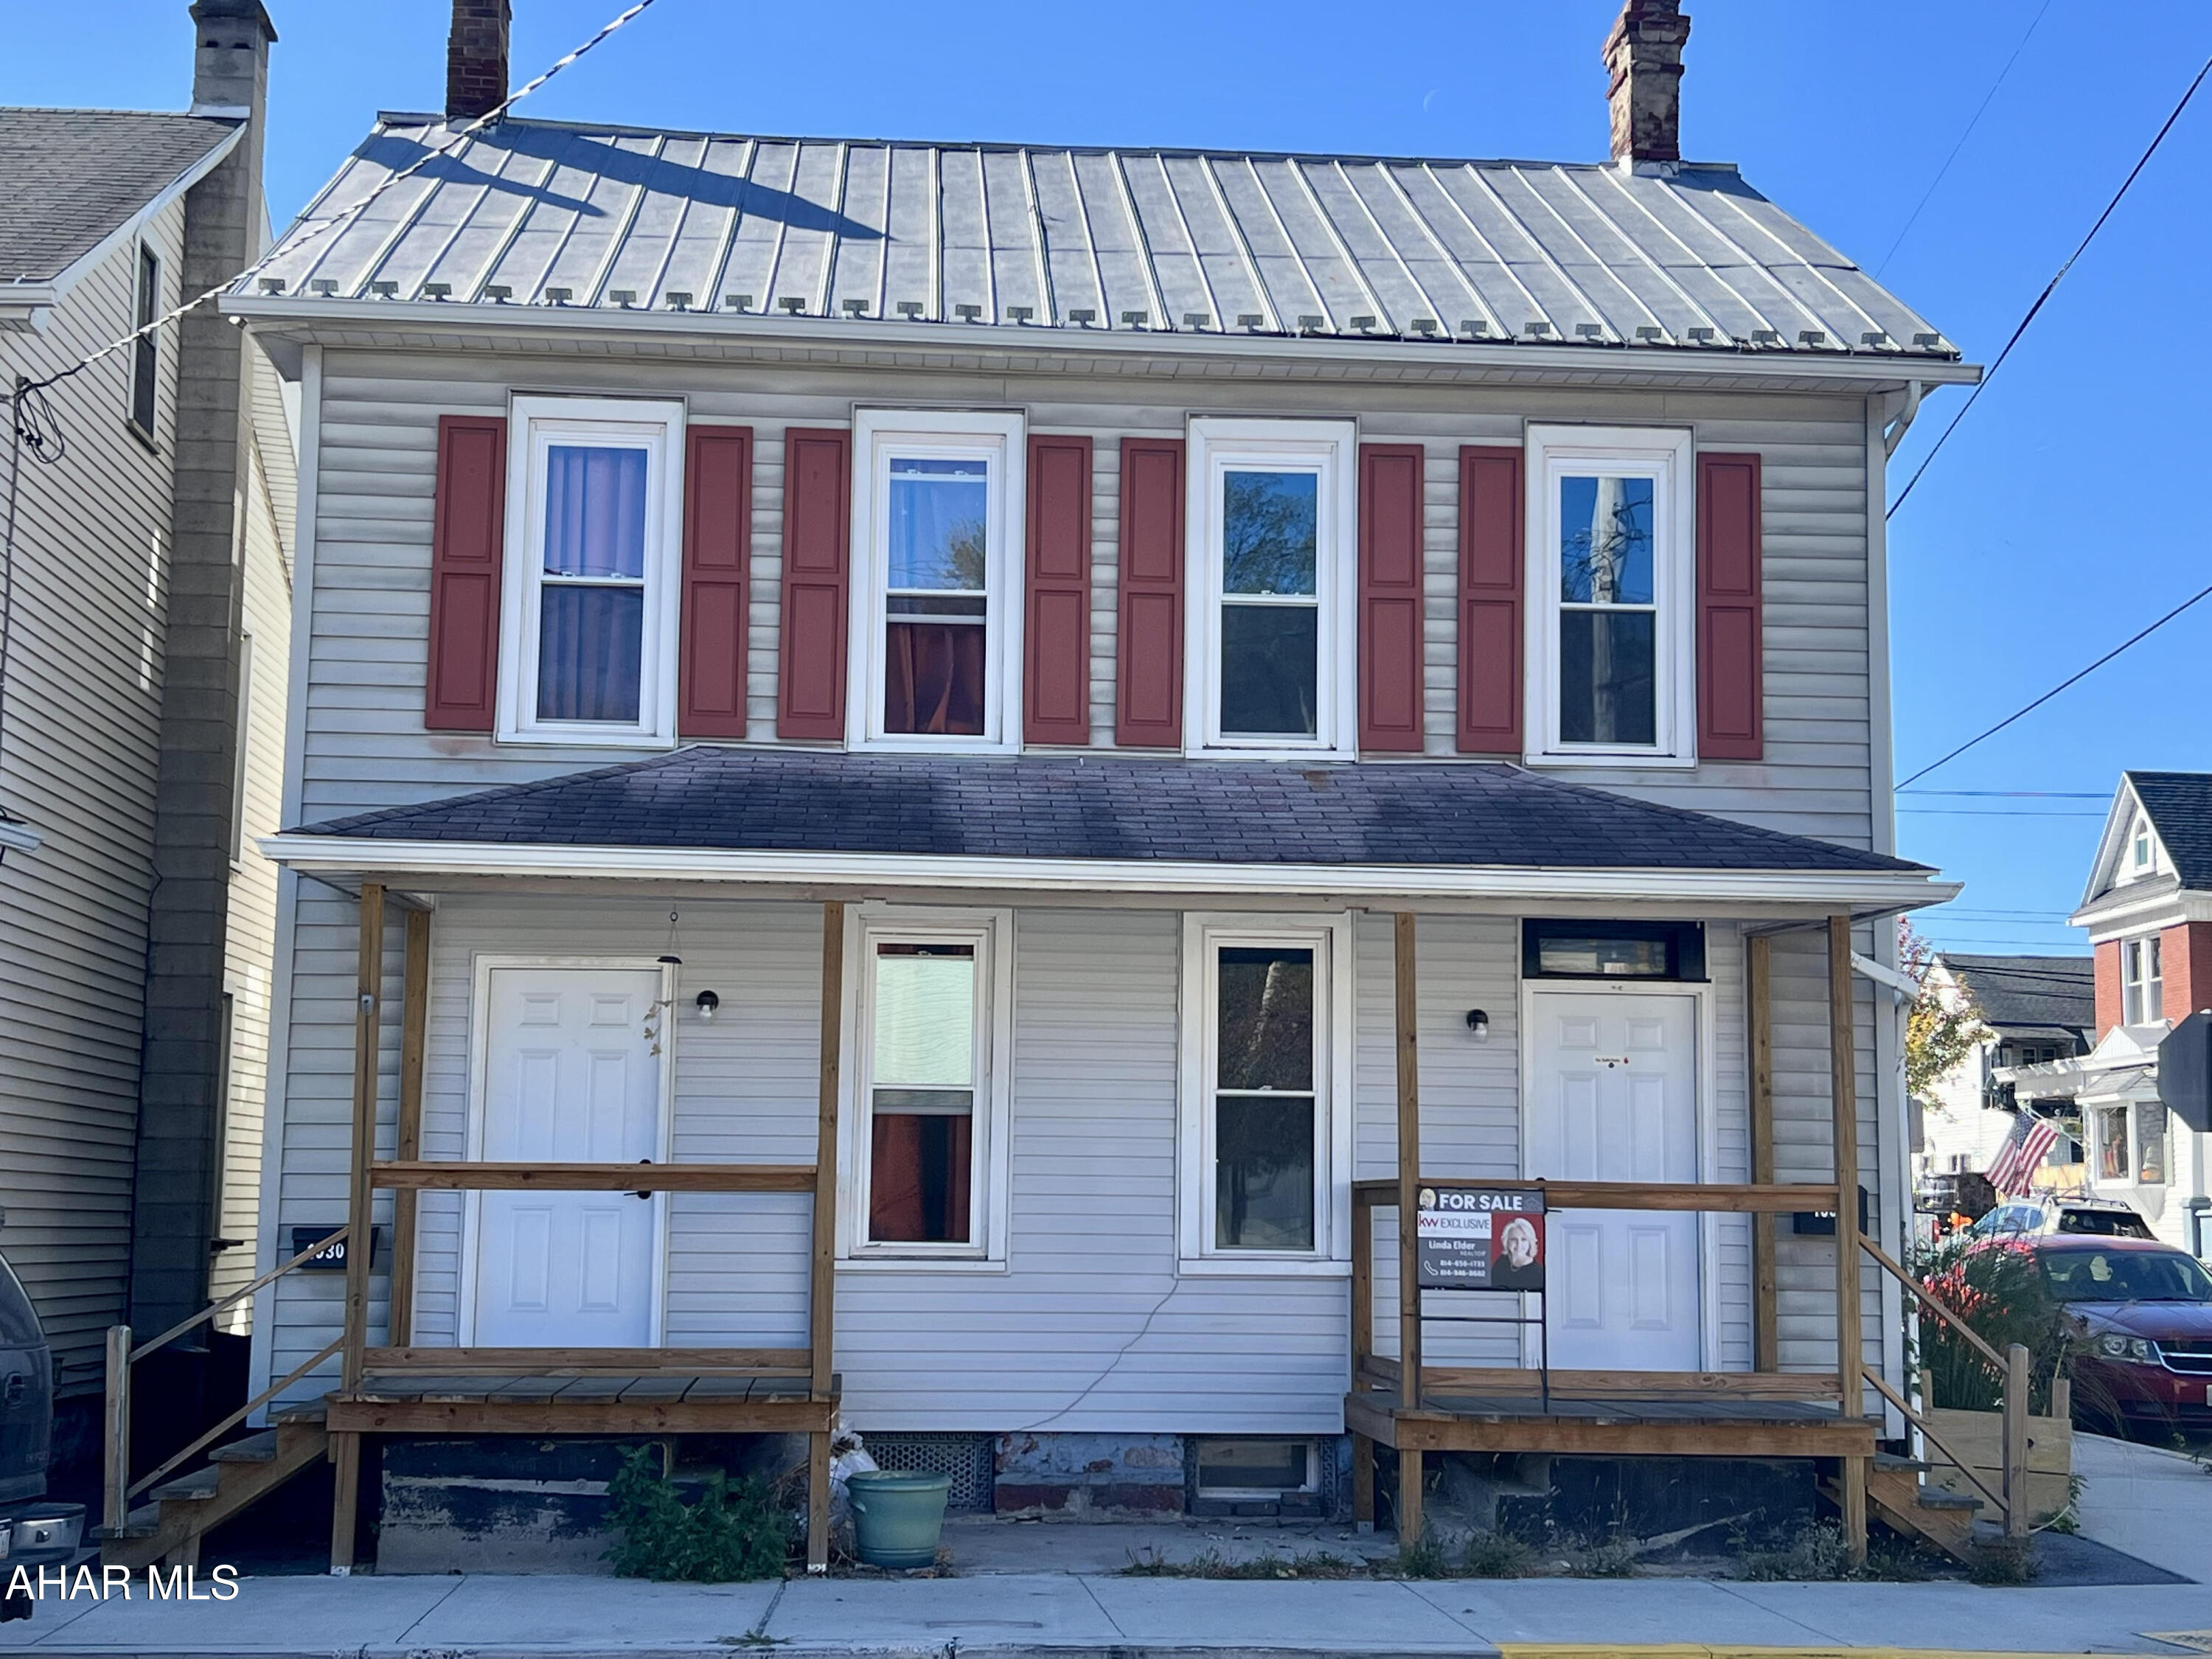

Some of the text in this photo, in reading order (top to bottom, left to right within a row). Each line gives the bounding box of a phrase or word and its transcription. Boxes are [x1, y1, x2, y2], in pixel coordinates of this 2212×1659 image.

[1439, 1193, 1523, 1211] FOR SALE
[1440, 1217, 1489, 1229] EXCLUSIVE
[1428, 1240, 1475, 1250] Linda Elder
